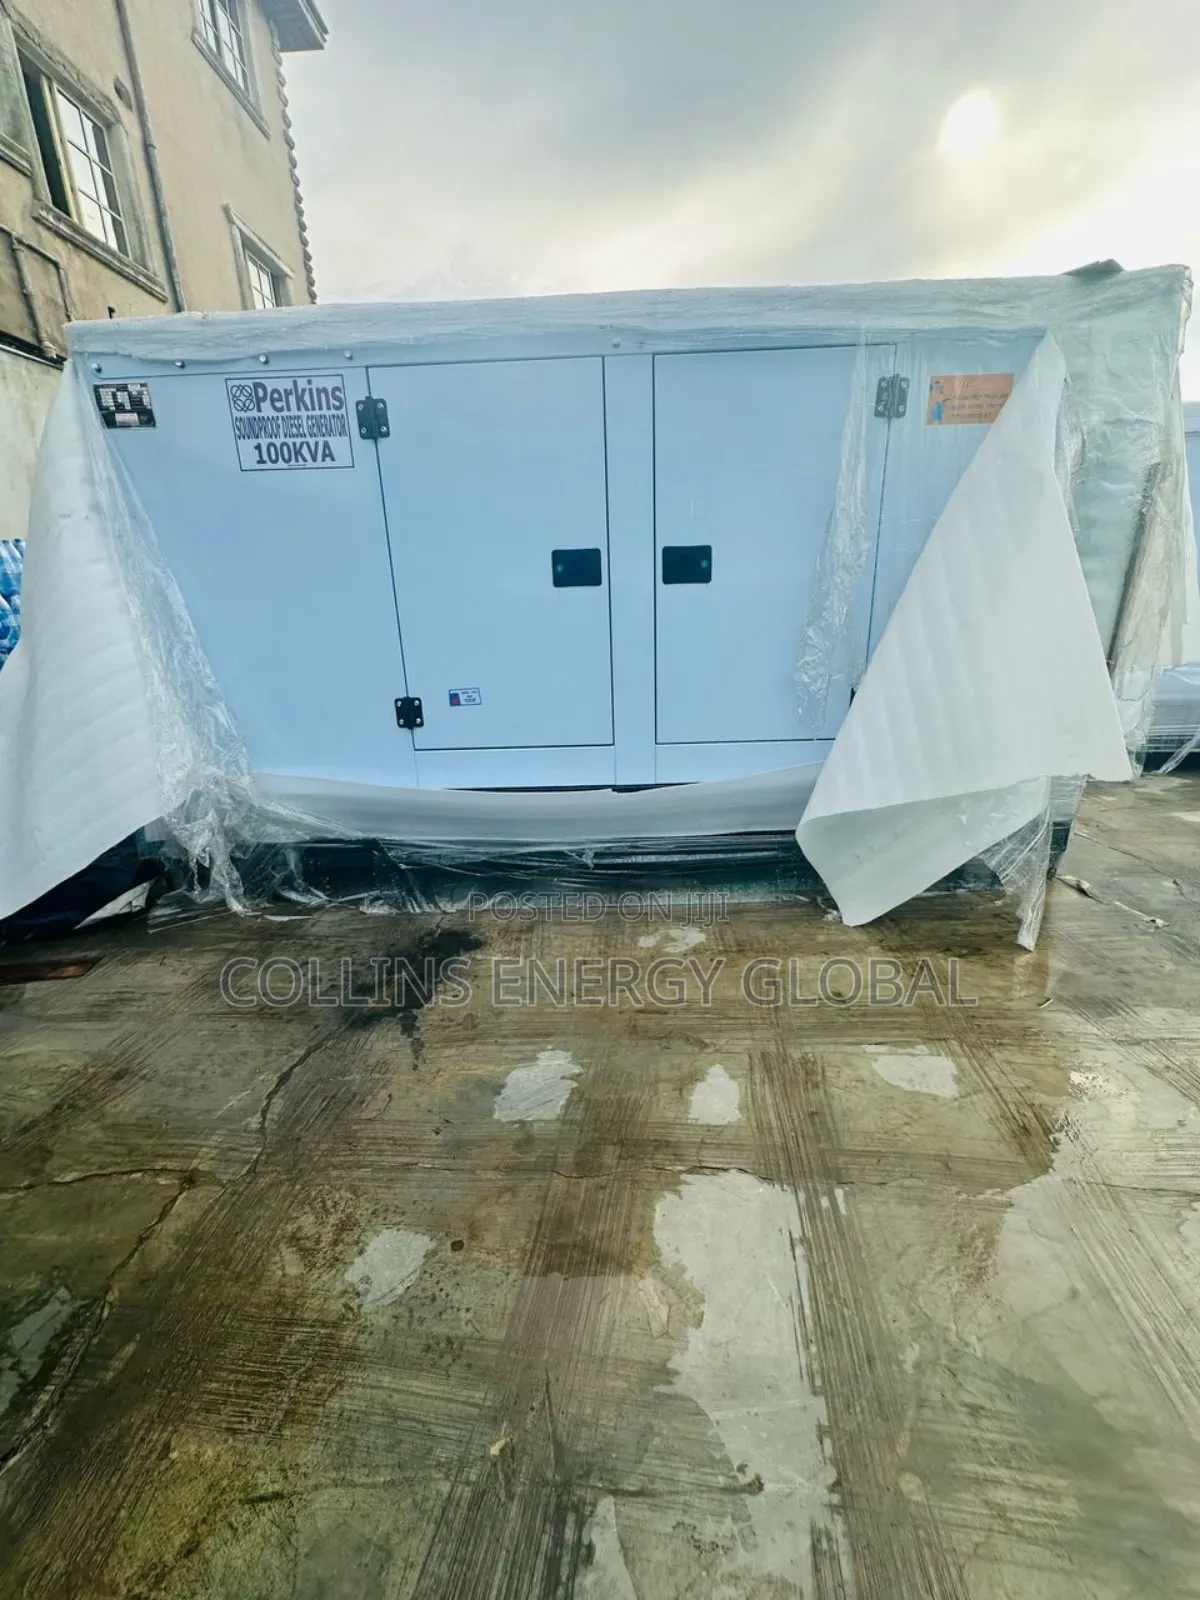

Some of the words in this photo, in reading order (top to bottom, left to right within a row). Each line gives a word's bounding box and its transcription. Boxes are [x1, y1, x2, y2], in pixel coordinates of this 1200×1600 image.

[254, 379, 345, 412] Perkins
[235, 416, 281, 441] SOUNDPROOF
[281, 414, 307, 438] DIESEL
[307, 413, 348, 438] GENERATOR
[254, 440, 336, 465] 100KVA
